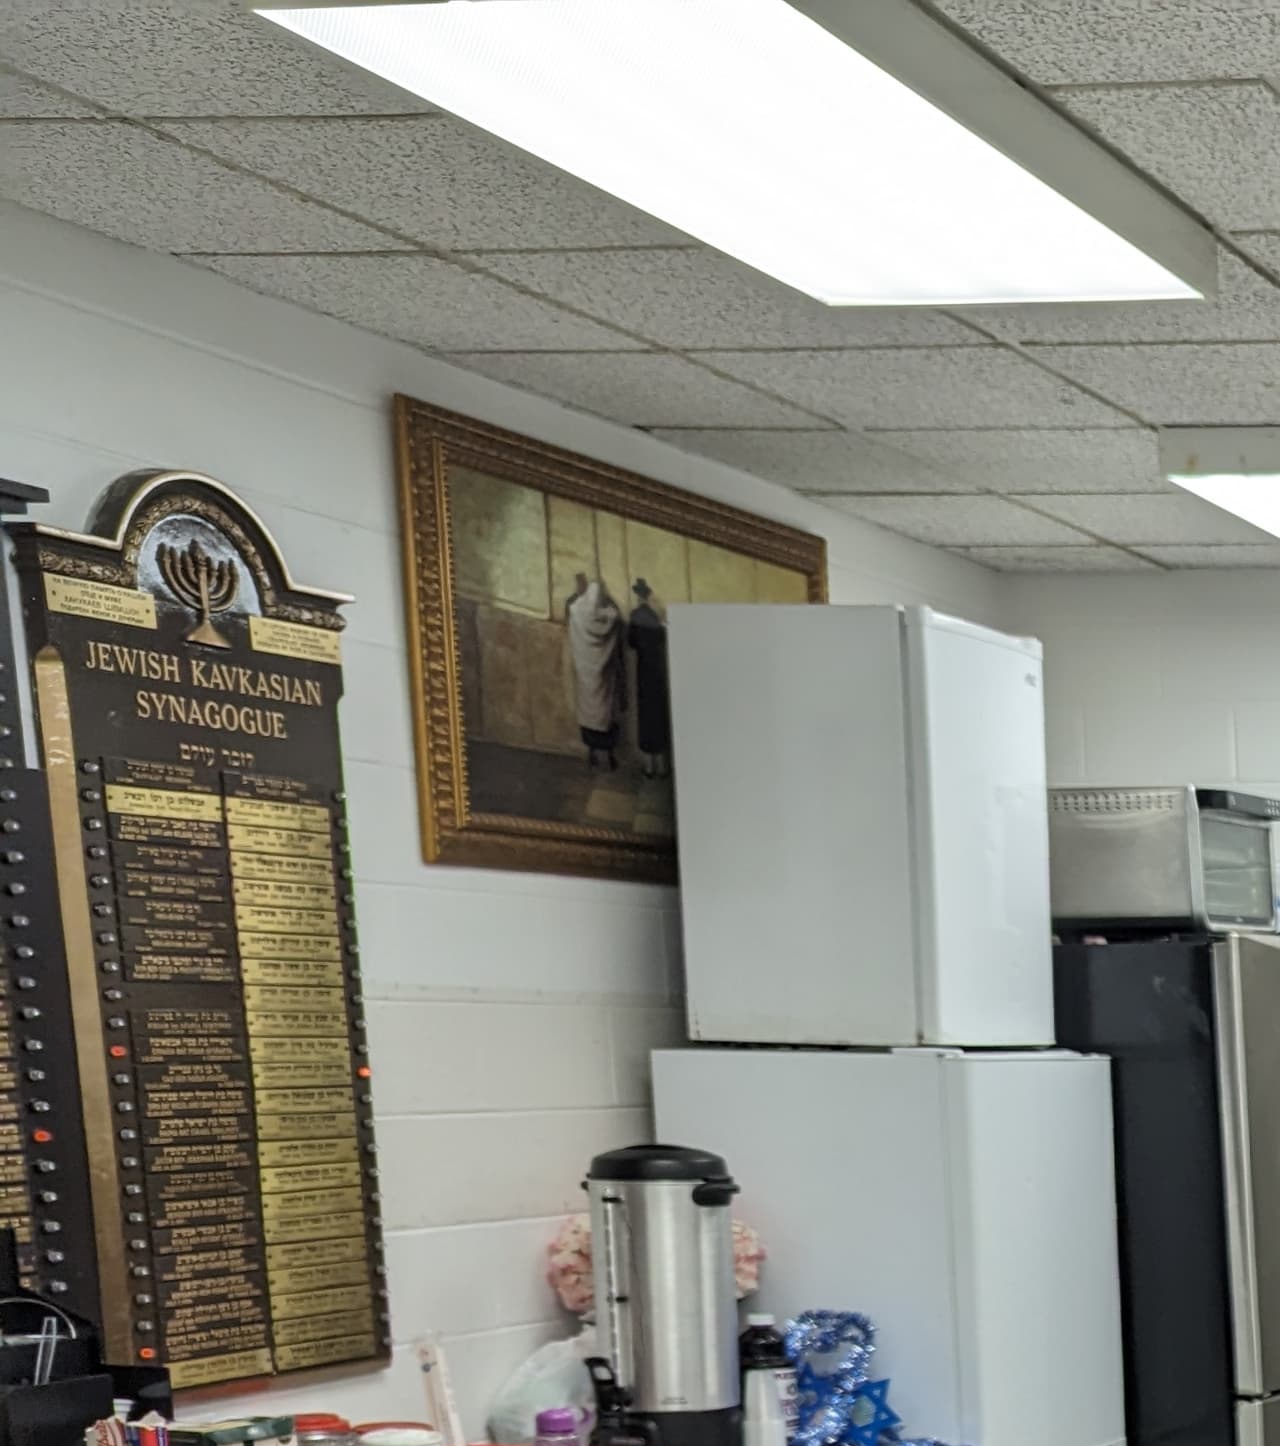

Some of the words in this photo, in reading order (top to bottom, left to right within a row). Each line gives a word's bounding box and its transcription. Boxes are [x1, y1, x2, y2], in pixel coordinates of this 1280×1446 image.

[86, 640, 181, 683] JEWISH
[192, 660, 323, 707] KAVKASIAN
[136, 690, 288, 739] SYNAGOGUE
